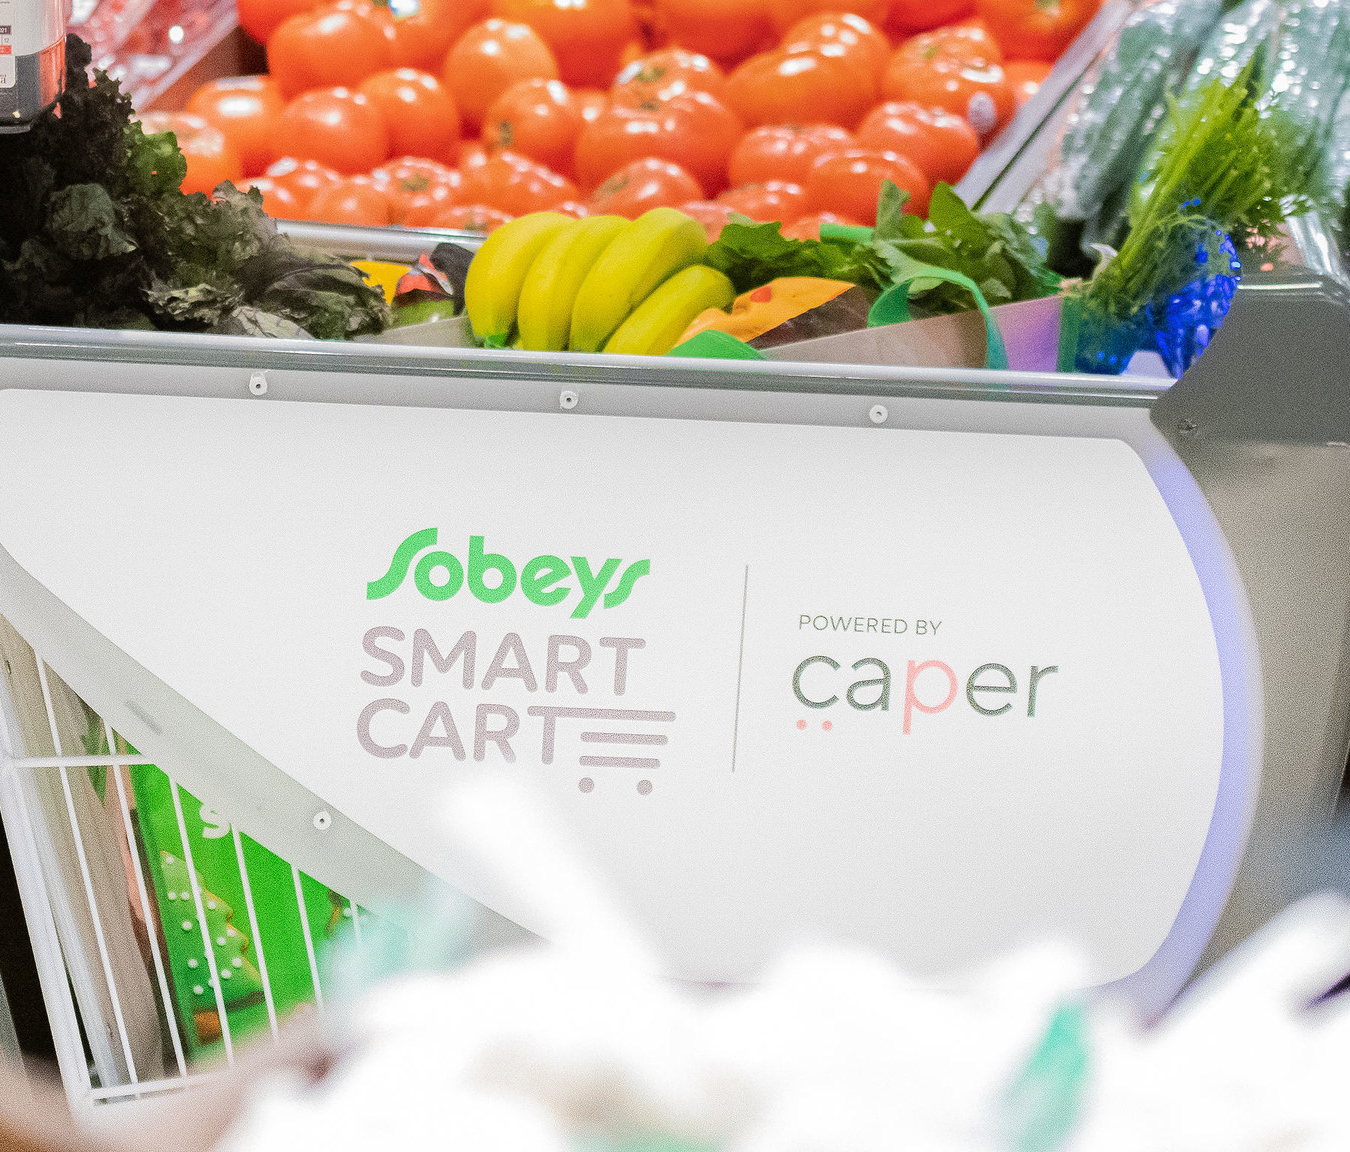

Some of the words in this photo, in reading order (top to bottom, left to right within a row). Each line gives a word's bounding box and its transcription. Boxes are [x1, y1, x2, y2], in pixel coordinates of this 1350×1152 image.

[366, 527, 650, 619] Sobeys
[360, 625, 646, 696] SMART
[799, 614, 908, 635] POWERED
[915, 619, 942, 636] BY
[792, 655, 1059, 735] caper
[356, 698, 676, 765] CART
